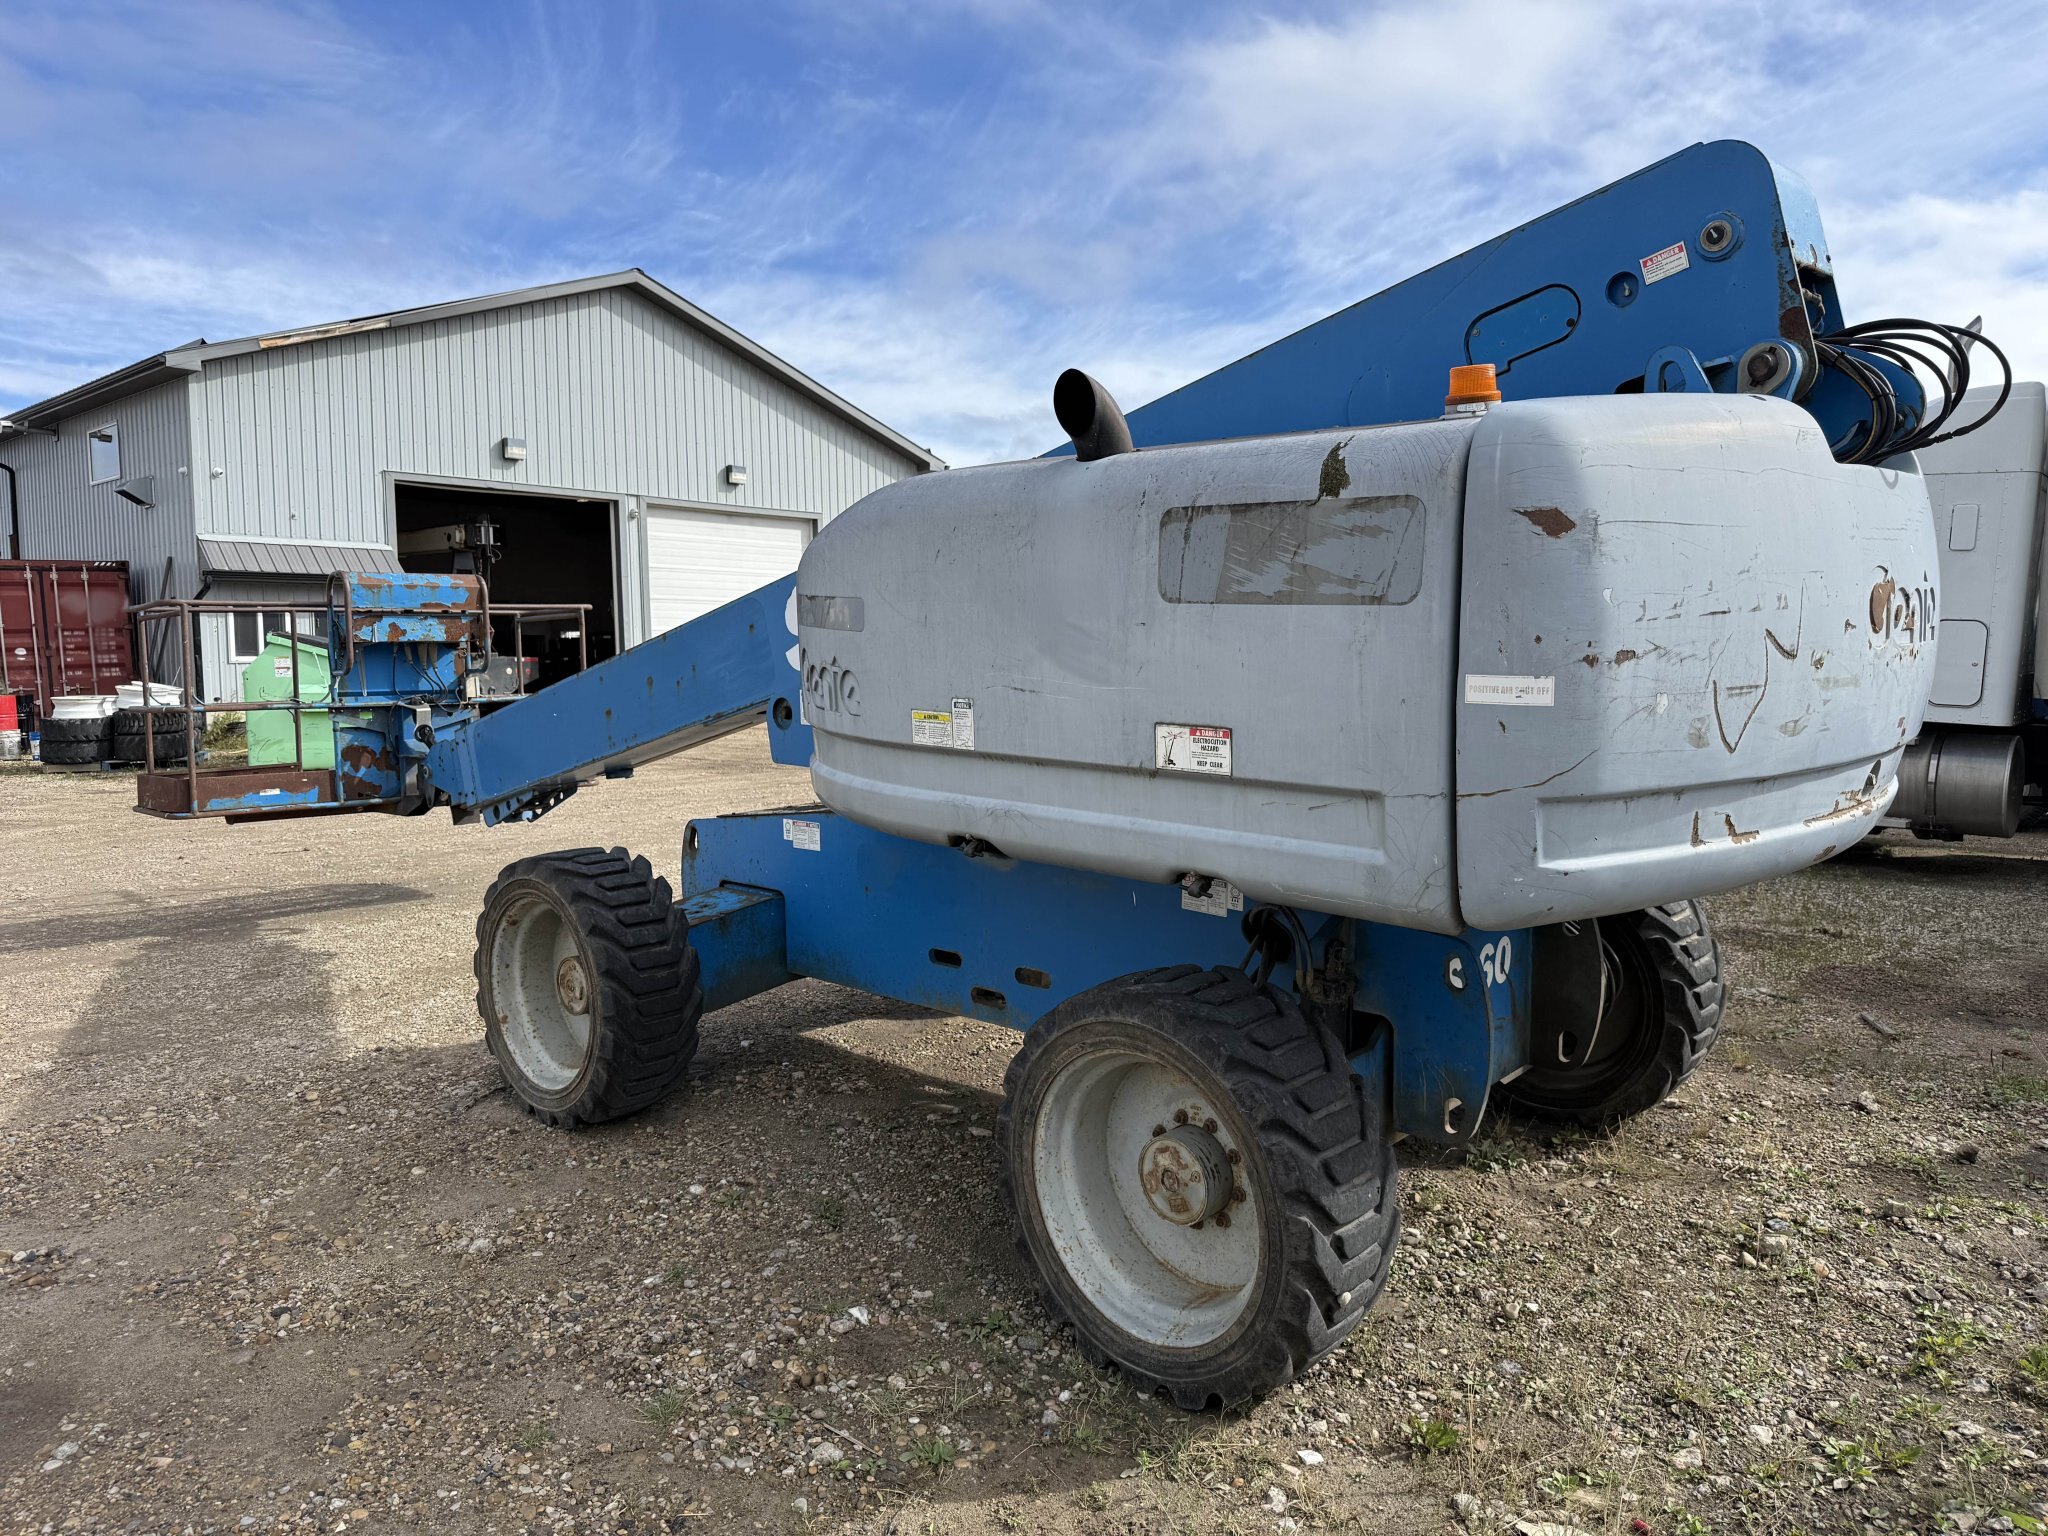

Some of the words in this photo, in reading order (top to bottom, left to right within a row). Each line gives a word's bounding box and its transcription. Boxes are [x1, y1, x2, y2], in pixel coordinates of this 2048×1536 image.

[1652, 246, 1680, 264] DANGER
[1469, 685, 1500, 694] POSITIVE
[1501, 686, 1513, 695] AIR
[1515, 686, 1534, 695] SHUT
[1536, 687, 1550, 695] OFF
